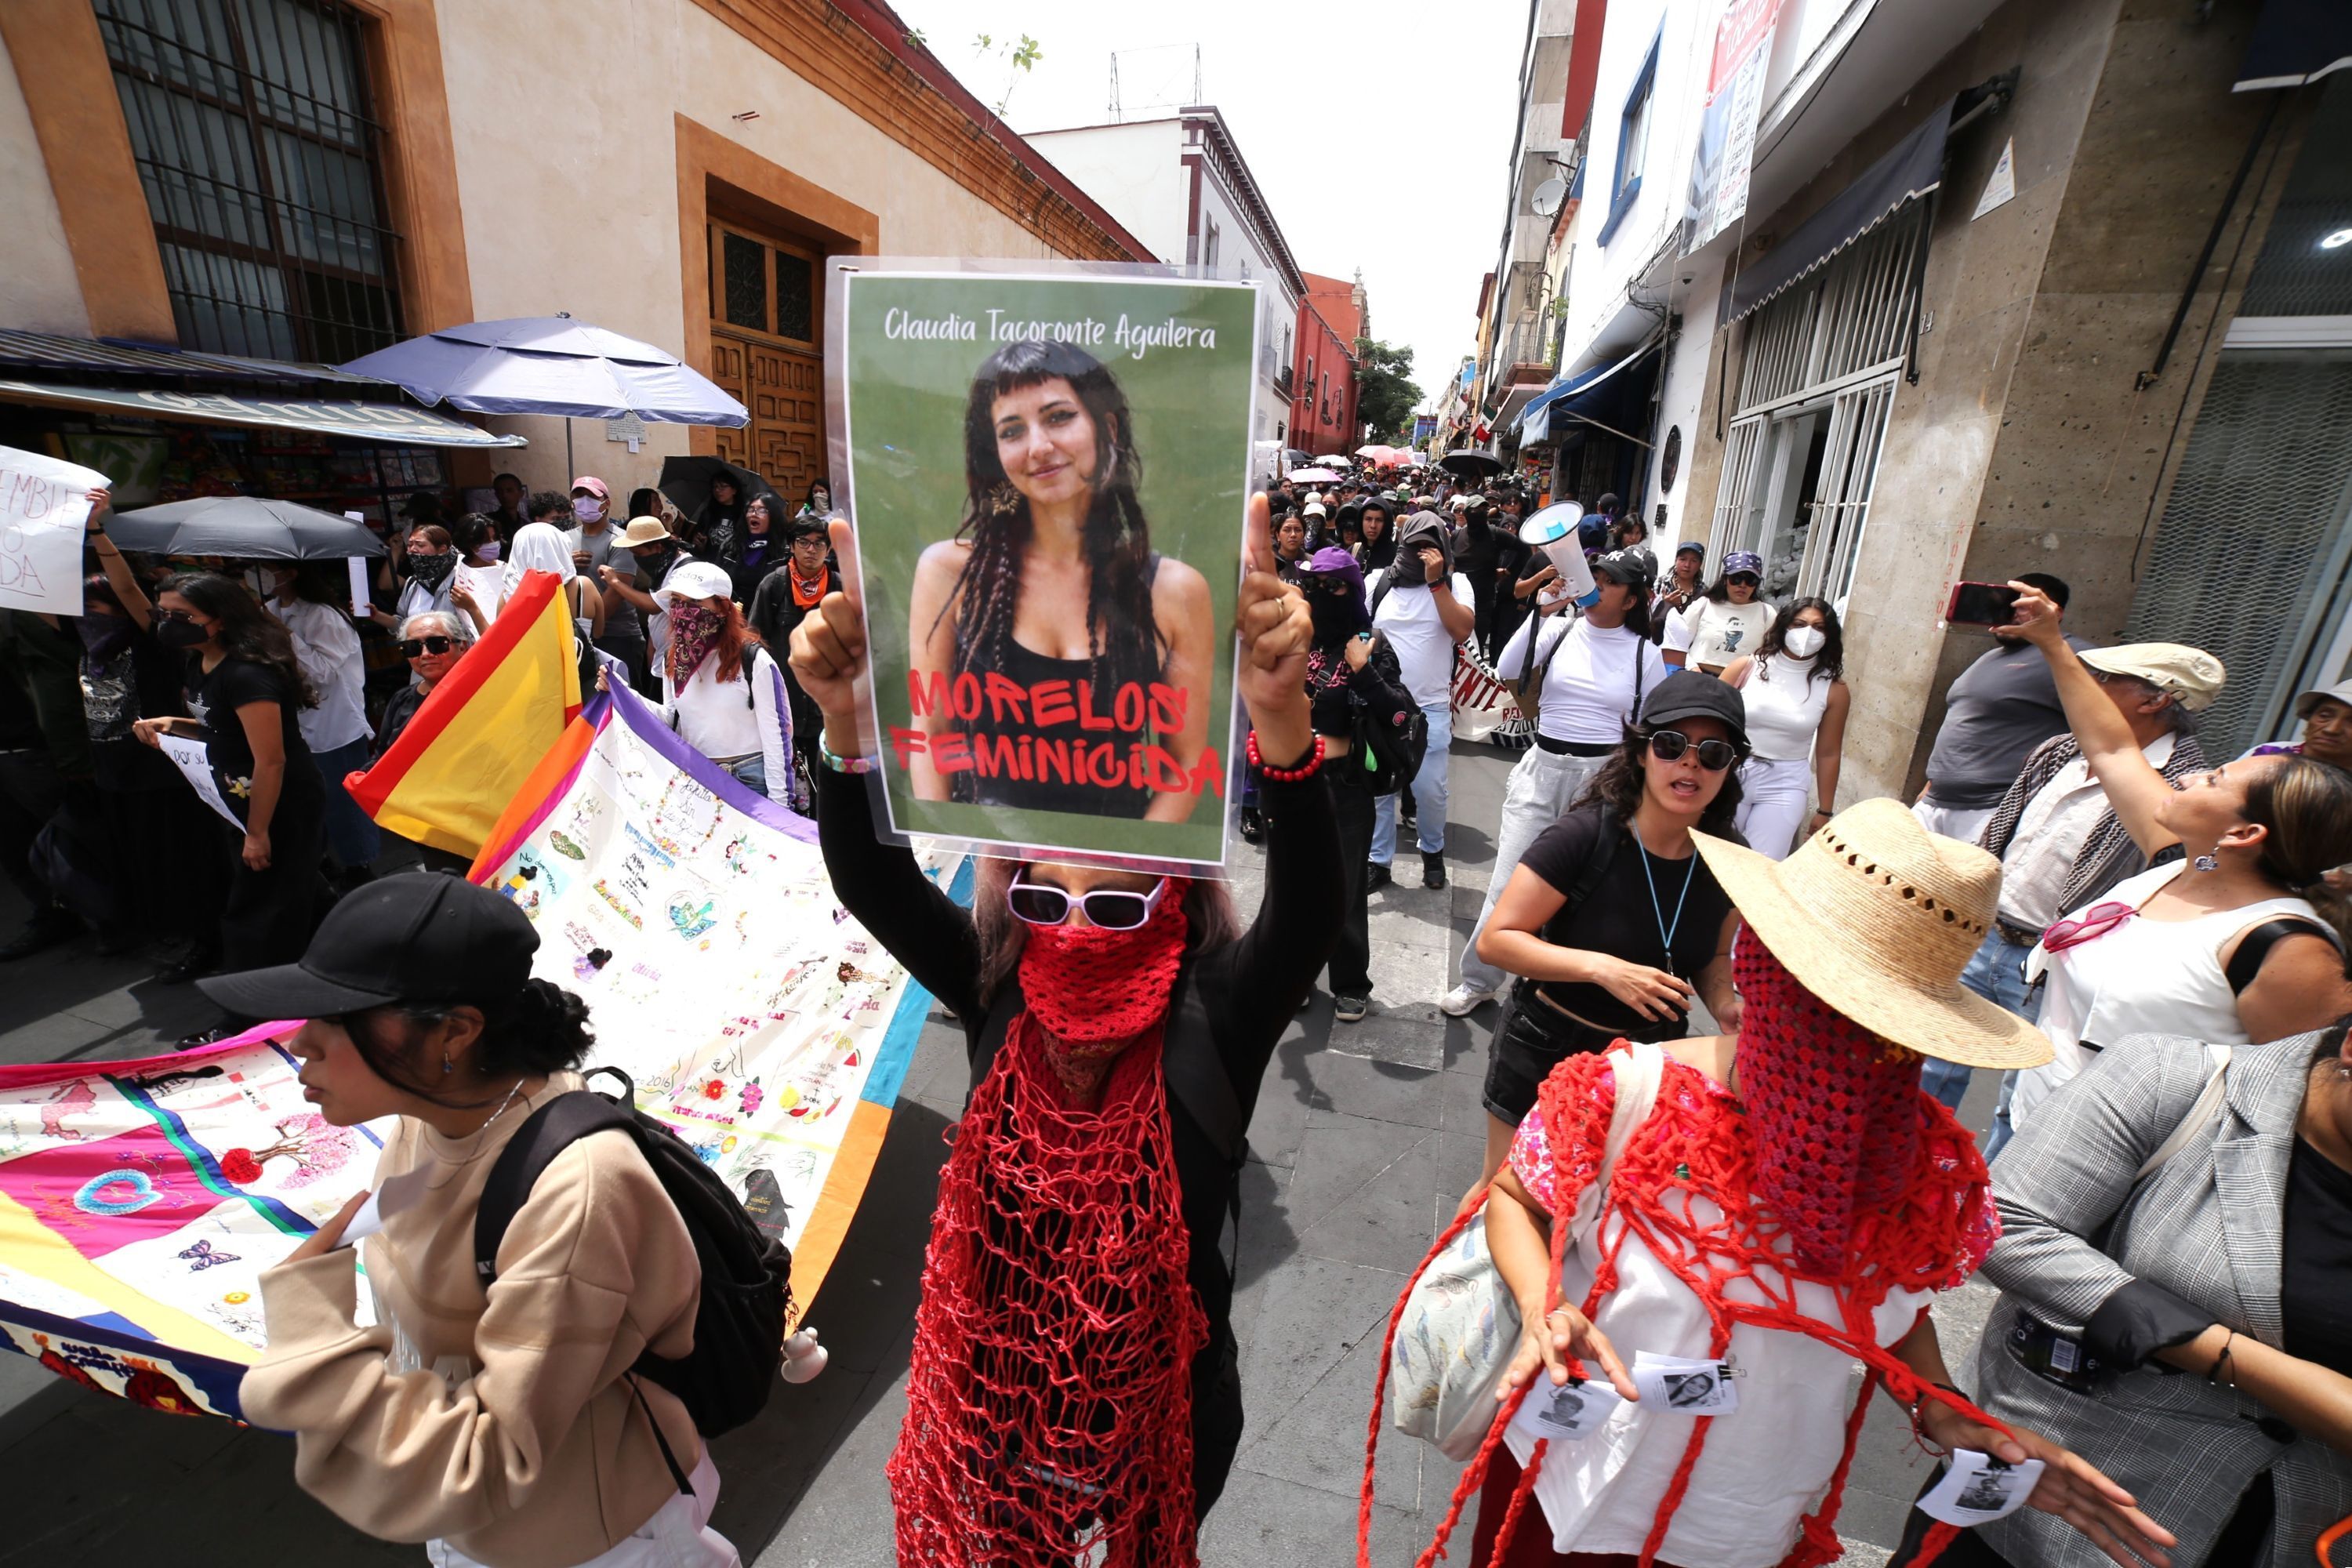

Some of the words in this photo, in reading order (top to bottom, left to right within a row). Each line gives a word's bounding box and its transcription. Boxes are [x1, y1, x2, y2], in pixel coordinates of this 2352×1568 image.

[884, 307, 976, 341] Claudia
[985, 308, 1106, 346] Tacoronte
[1113, 313, 1216, 361] Aguilera
[907, 669, 1188, 735] MORELOS
[519, 852, 533, 862] No
